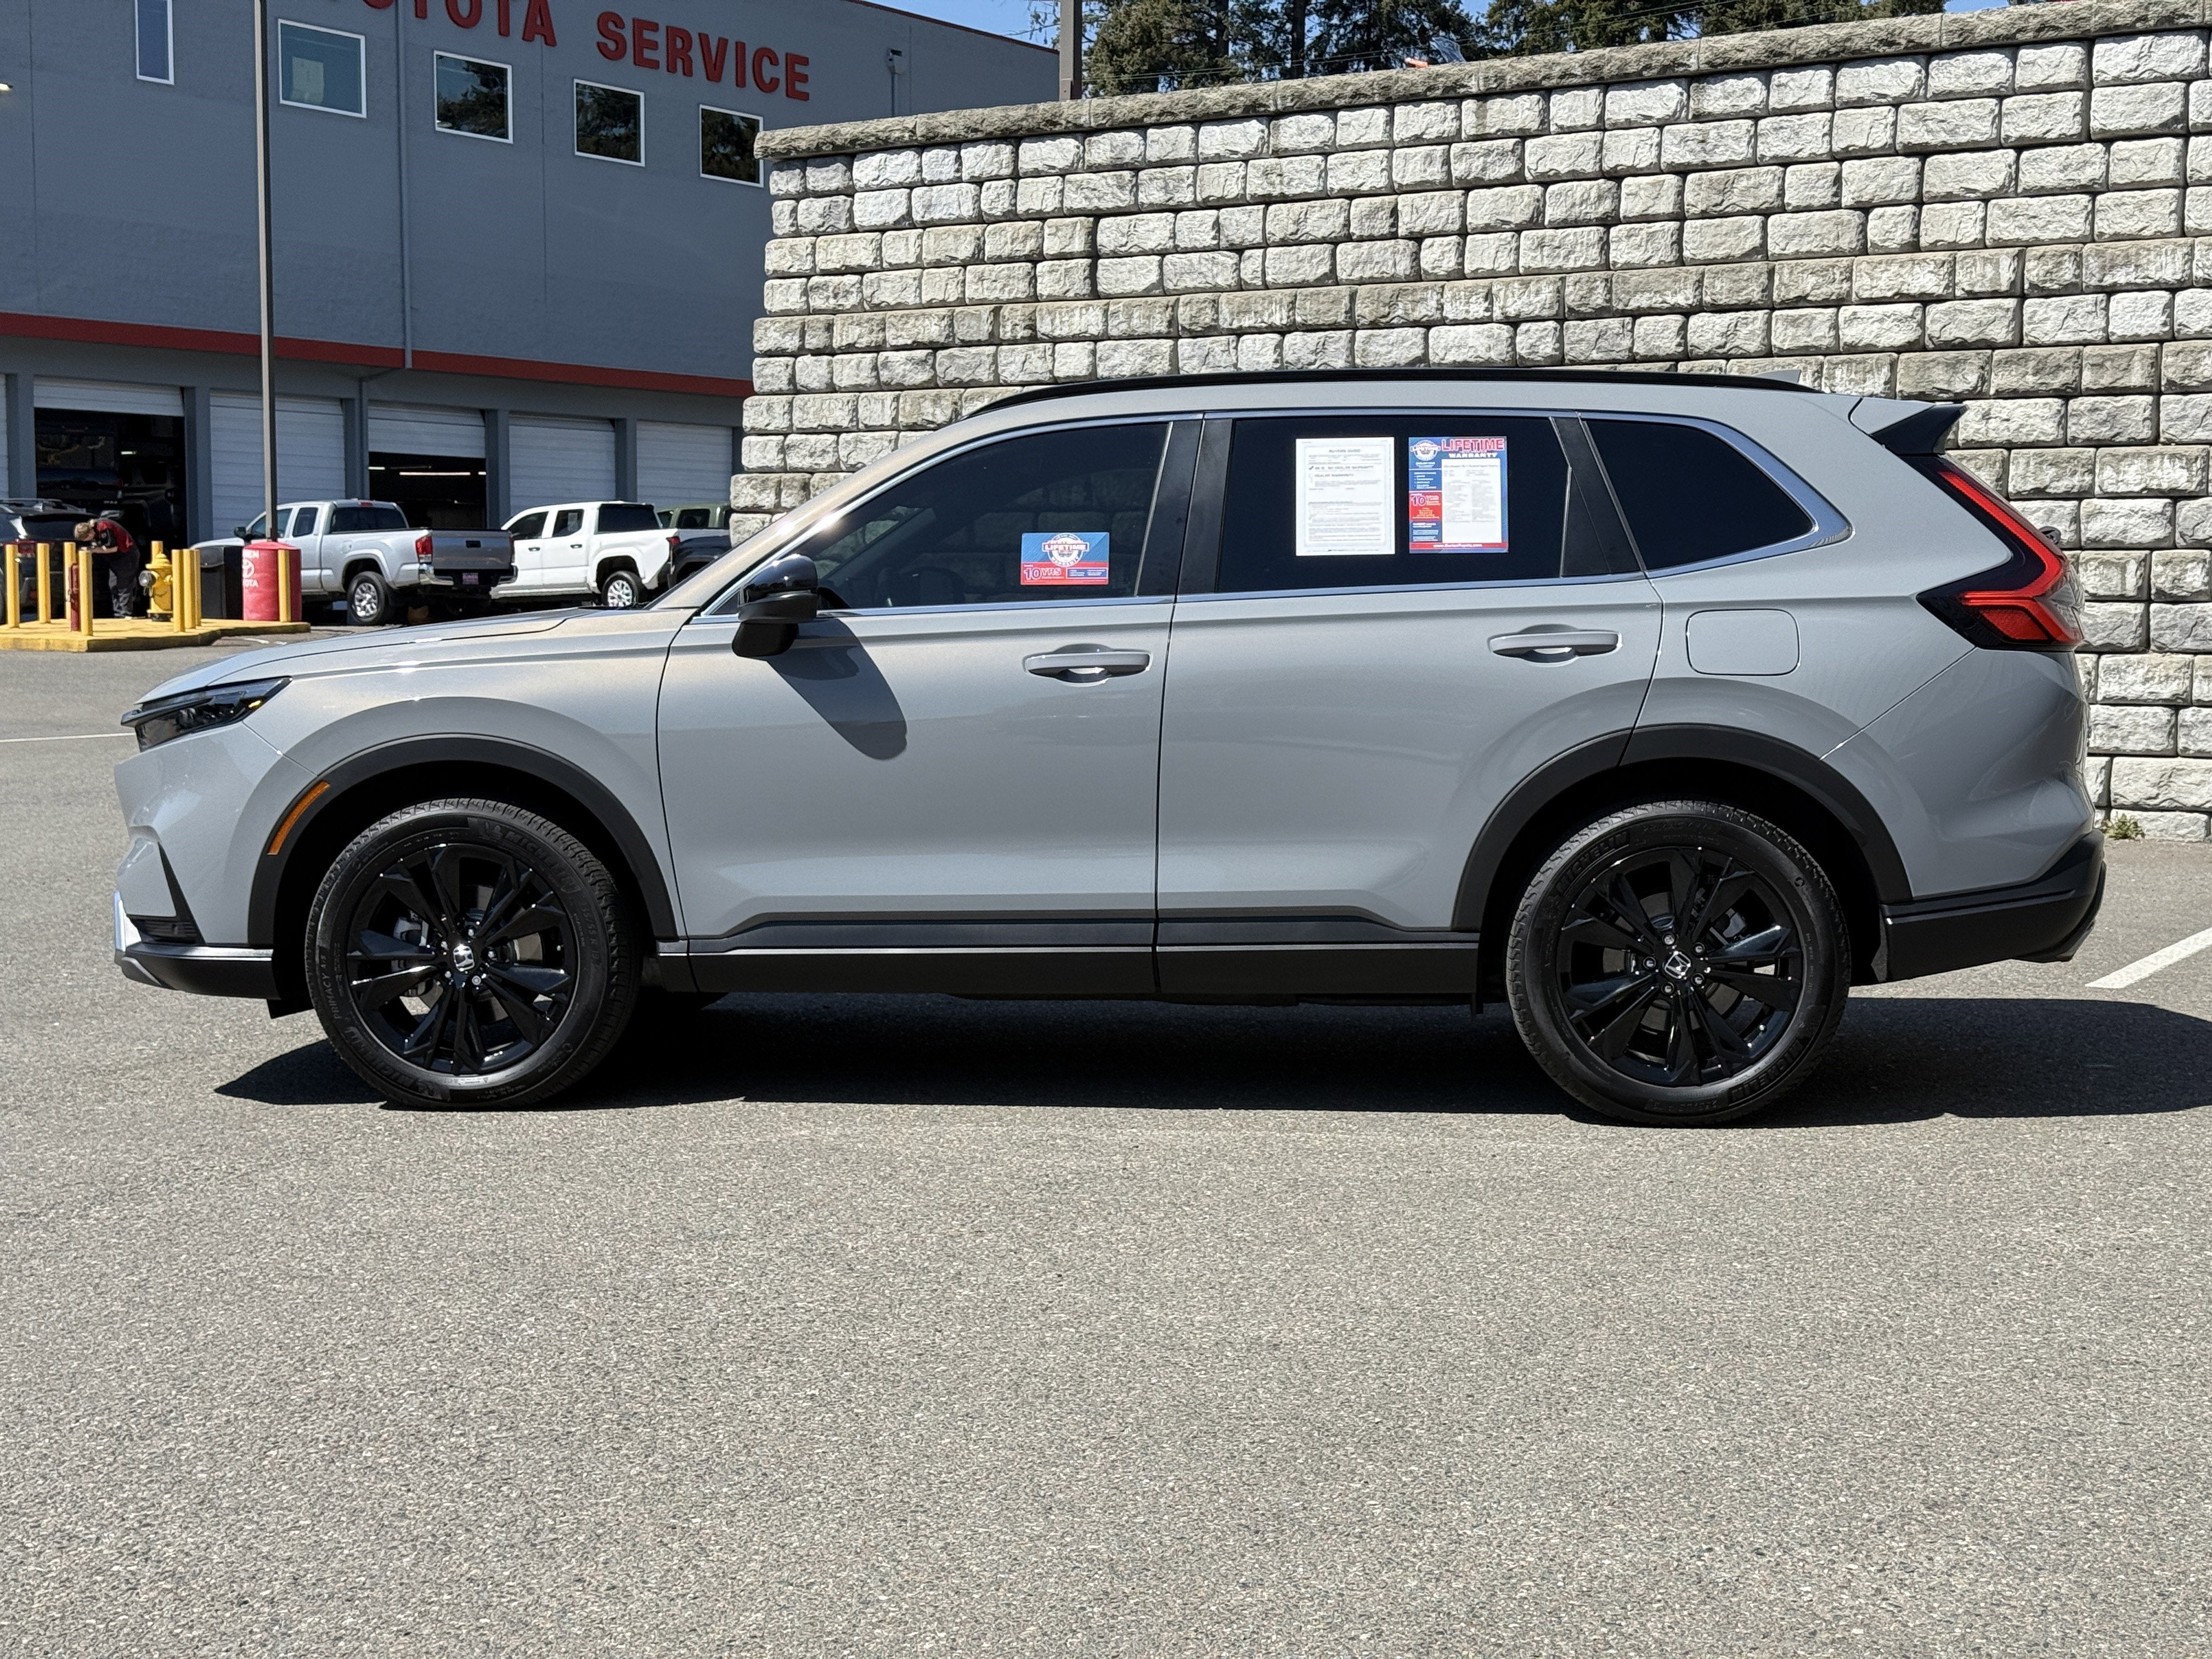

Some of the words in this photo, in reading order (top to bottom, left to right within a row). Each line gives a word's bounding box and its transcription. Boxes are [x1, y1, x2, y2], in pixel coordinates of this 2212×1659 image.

[330, 0, 557, 46] OTA
[596, 11, 809, 101] SERVICE
[1442, 439, 1505, 452] LIFETIME
[1410, 495, 1426, 506] 10
[1024, 567, 1041, 580] 10
[505, 831, 575, 885] MICHELIN
[1556, 832, 1627, 894] MICHELIN
[321, 972, 342, 1019] PRIMACY
[1731, 1040, 1803, 1101] MICHELIN
